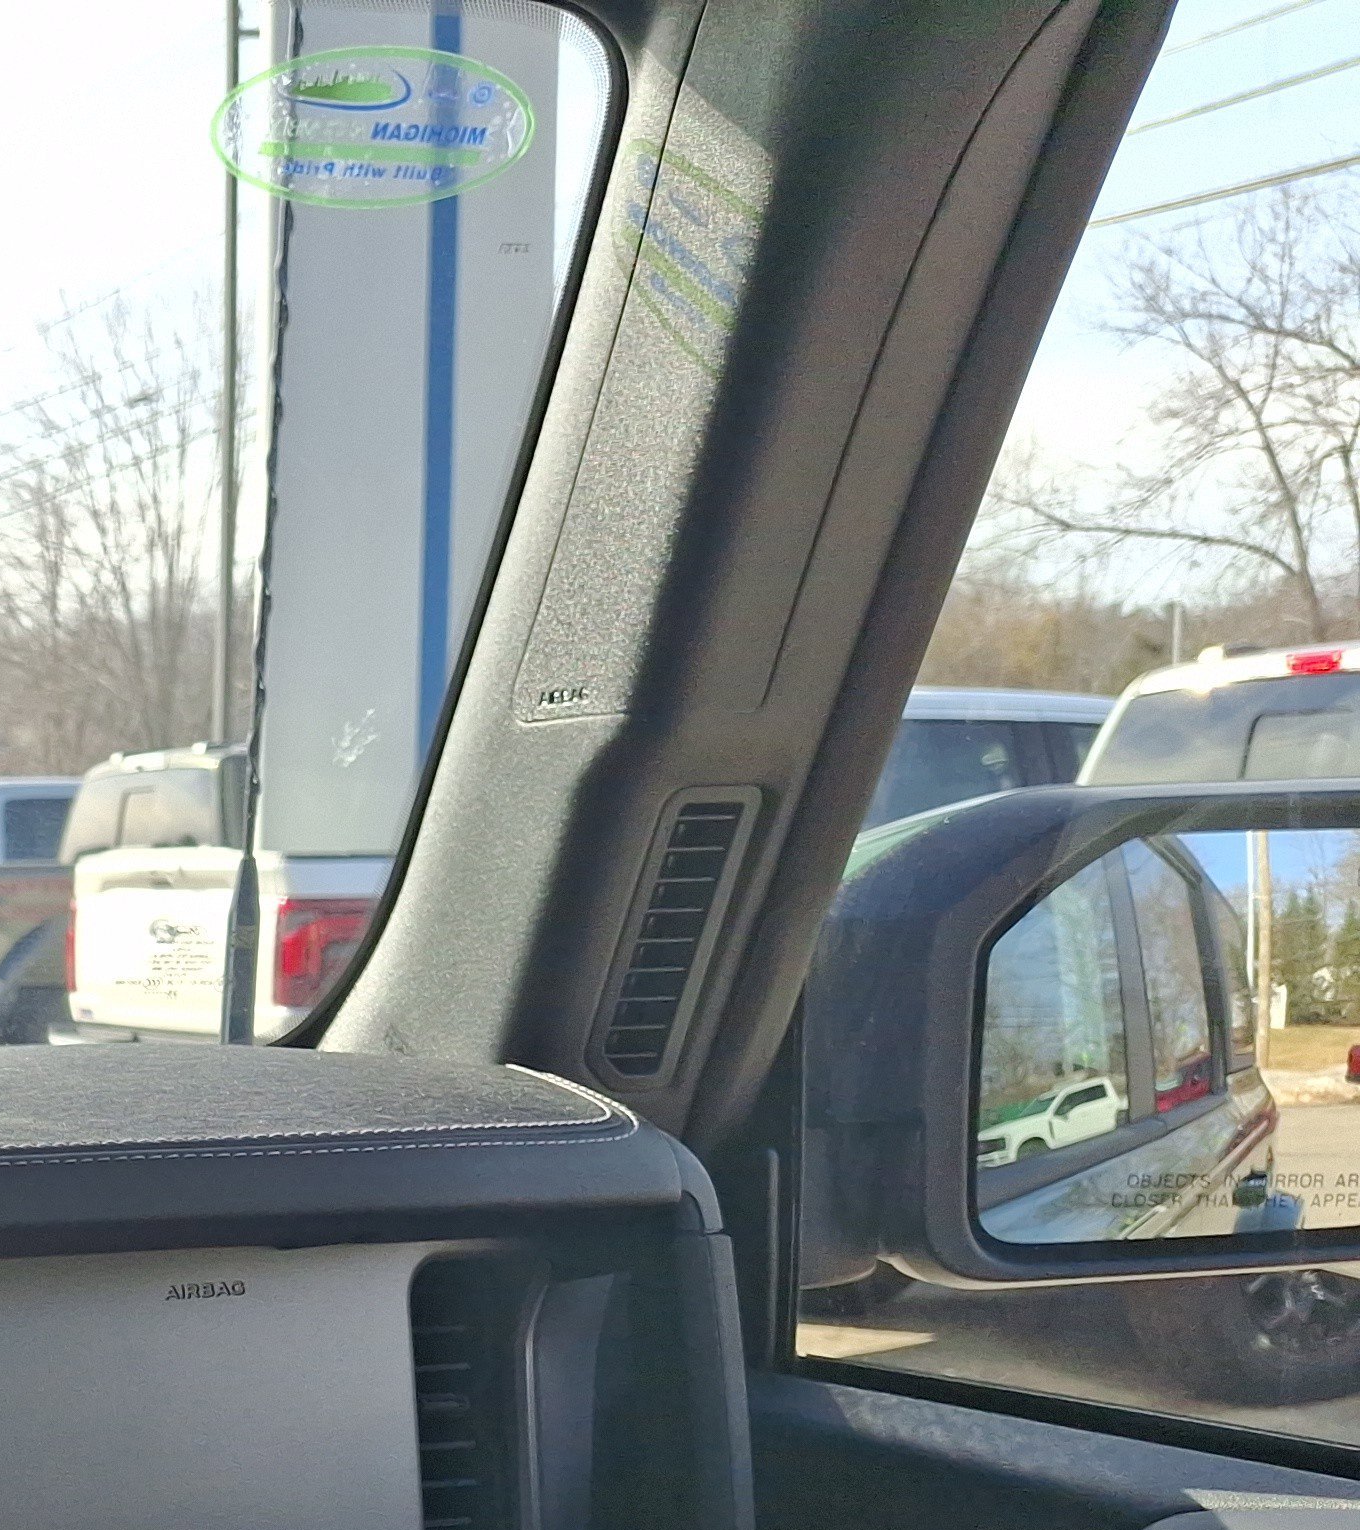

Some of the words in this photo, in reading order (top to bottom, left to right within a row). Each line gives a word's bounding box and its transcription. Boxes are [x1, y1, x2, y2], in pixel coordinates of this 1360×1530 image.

[1127, 1173, 1211, 1188] OBJECTS
[1257, 1173, 1324, 1188] IRROR
[1111, 1193, 1182, 1208] CLOSER
[1197, 1193, 1237, 1208] THA
[1311, 1193, 1360, 1208] APPE
[164, 1280, 247, 1302] AIRBAG
